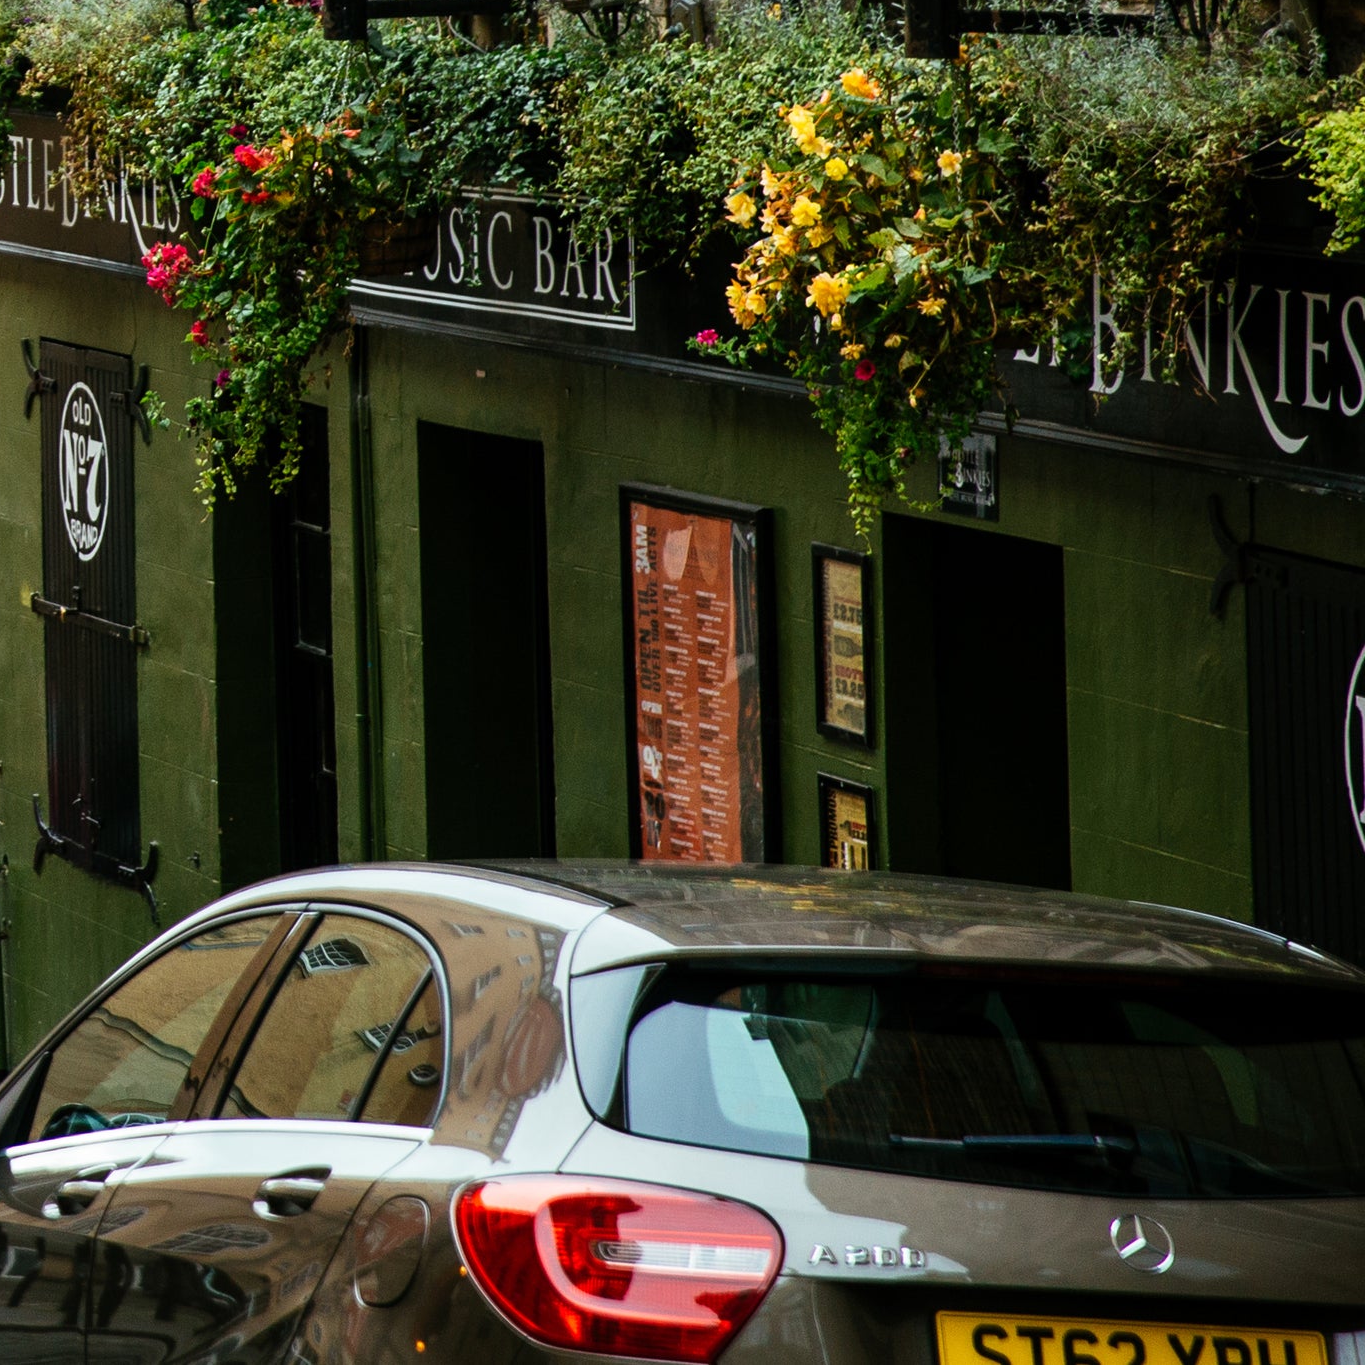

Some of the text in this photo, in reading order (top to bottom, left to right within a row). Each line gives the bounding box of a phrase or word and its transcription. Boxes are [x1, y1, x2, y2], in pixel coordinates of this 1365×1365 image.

[531, 213, 621, 305] BAR
[71, 396, 93, 427] OLD
[69, 517, 99, 551] BRAND
[635, 524, 651, 575] 3AM
